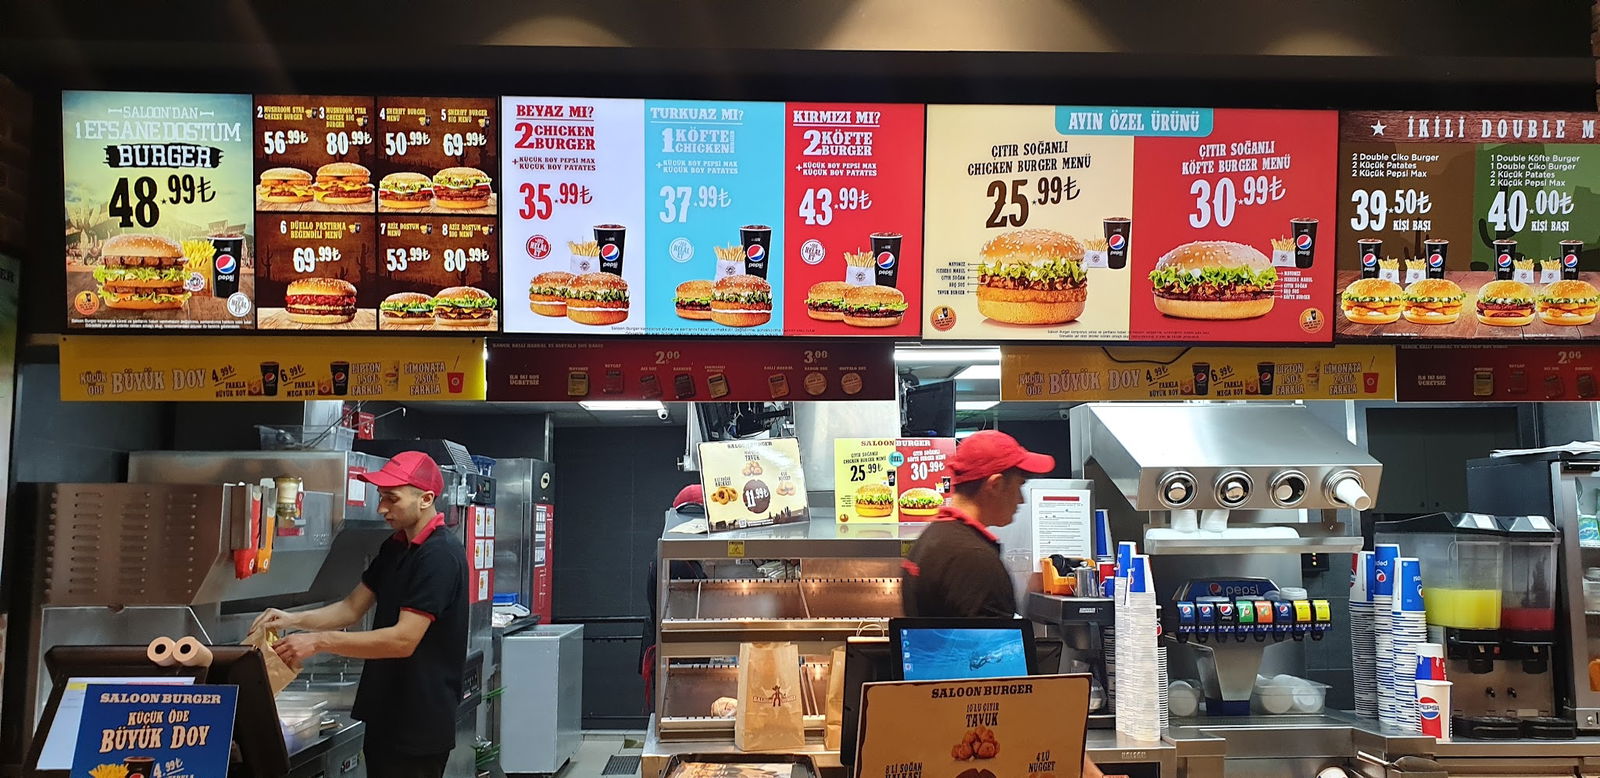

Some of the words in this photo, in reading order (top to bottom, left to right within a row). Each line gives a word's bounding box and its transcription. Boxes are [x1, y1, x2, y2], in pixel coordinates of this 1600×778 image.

[257, 106, 263, 118] 2
[319, 107, 325, 119] 3
[379, 107, 386, 120] 4
[441, 109, 447, 121] 5
[516, 104, 564, 117] BEYAZ
[569, 106, 594, 118] MI?
[650, 107, 717, 120] TURKUAZ
[721, 109, 744, 121] MI?
[793, 111, 852, 124] KIRMIZI
[856, 112, 881, 124] MI?
[1068, 112, 1104, 130] AYIN
[1110, 110, 1145, 131] ÖZEL
[1151, 111, 1200, 132] ÜRÜNÜ
[1408, 116, 1465, 138] İKİLİ
[1481, 119, 1567, 139] DOUBLE
[84, 120, 162, 141] EFSANE
[163, 122, 241, 142] DOSTUM
[514, 122, 535, 149] 2
[534, 125, 595, 137] CHICKEN
[535, 138, 596, 150] BURGER
[662, 128, 675, 153] 1
[675, 126, 729, 143] KÖFTE
[803, 129, 822, 156] 2
[822, 129, 873, 145] KÖFTE
[675, 142, 730, 153] CHICKEN
[821, 145, 872, 156] BURGER
[991, 144, 1019, 160] ÇITIR
[1024, 140, 1069, 156] SOĞANLI
[1199, 143, 1226, 160] ÇITIR
[1230, 140, 1275, 156] SOĞANLI
[117, 145, 212, 167] BURGER
[1360, 153, 1389, 161] Double
[1411, 153, 1440, 162] Burger
[1496, 154, 1526, 162] Double
[1528, 154, 1550, 162] Köfte
[1552, 155, 1581, 164] Burger
[967, 161, 1013, 176] CHICKEN
[1017, 159, 1058, 172] BURGER
[1062, 153, 1092, 169] MENÜ
[1181, 159, 1214, 175] KÖFTE
[1218, 158, 1258, 173] BURGER
[1262, 153, 1292, 170] MENÜ
[1351, 161, 1358, 169] 2
[1359, 161, 1385, 170] Küçük
[1548, 163, 1576, 172] Burger
[1351, 169, 1358, 177] 2
[1359, 169, 1385, 178] Küçük
[1386, 170, 1409, 178] Pepsi
[1498, 171, 1523, 179] Küçük
[1525, 171, 1555, 179] Patates
[1497, 179, 1523, 188] Küçük
[1525, 179, 1547, 188] Pepsi
[280, 220, 287, 234] 6
[380, 223, 386, 235] 7
[442, 223, 448, 236] 8
[1393, 219, 1410, 232] KİŞİ
[1412, 220, 1431, 232] BAŞI
[1531, 219, 1548, 233] KİŞİ
[1551, 220, 1570, 233] BAŞI
[112, 367, 165, 394] BÜYÜK
[172, 368, 207, 391] DOY
[1049, 369, 1100, 394] BÜYÜK
[1108, 369, 1142, 391] DOY
[1225, 584, 1260, 596] pepsi
[931, 686, 983, 699] SALOON
[984, 684, 1034, 696] BURGER
[100, 693, 160, 704] SALOON
[161, 694, 221, 705] BURGER
[128, 710, 164, 726] KÜÇÜK
[168, 709, 190, 724] ÖDE
[966, 712, 1000, 728] TAVUK
[99, 726, 164, 754] BÜYÜK
[170, 725, 210, 749] DOY
[1028, 761, 1057, 774] NUGGET
